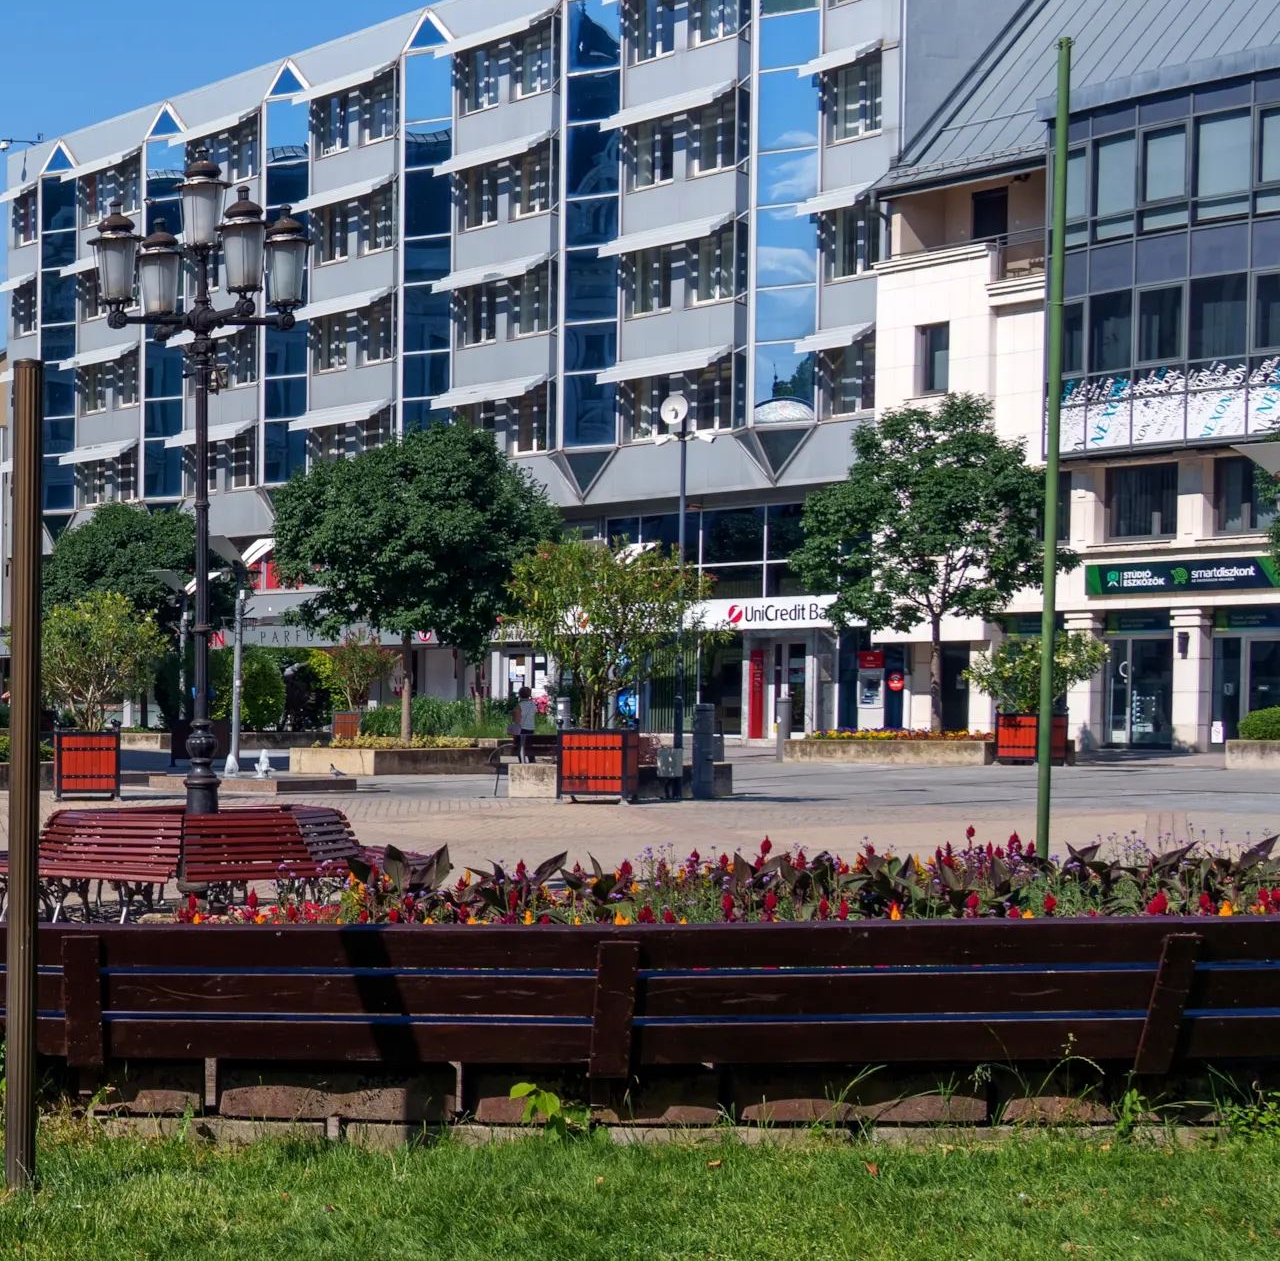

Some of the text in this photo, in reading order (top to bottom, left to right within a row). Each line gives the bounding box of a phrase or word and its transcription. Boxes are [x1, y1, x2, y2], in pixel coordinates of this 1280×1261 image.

[1199, 395, 1232, 438] NEXON
[1123, 569, 1152, 579] STÚDIÓ
[1191, 565, 1255, 579] smartdiszkont
[1123, 577, 1165, 587] ESZKÖZÖK
[745, 603, 828, 622] UniCredit Ba
